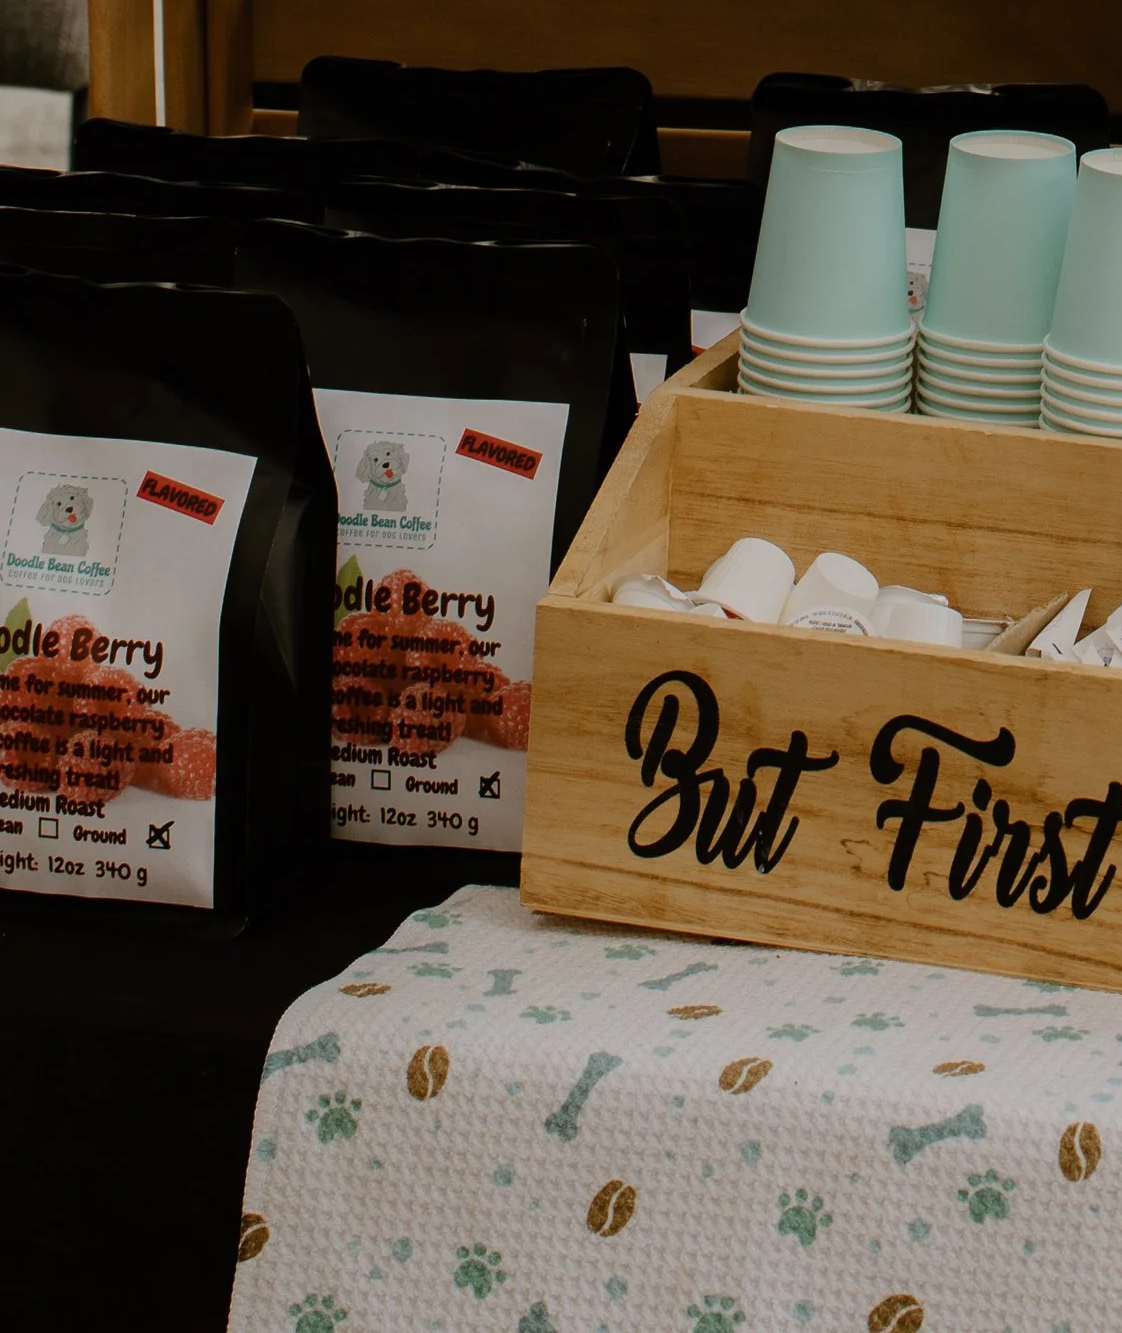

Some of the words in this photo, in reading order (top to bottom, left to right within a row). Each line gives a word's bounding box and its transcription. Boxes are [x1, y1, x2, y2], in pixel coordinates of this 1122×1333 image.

[460, 434, 537, 473] FLAVORED
[141, 477, 217, 519] FLAVORED
[371, 514, 397, 529] Bean
[399, 516, 432, 532] Coffee
[6, 553, 45, 570] Doodle
[47, 558, 74, 573] Bean
[77, 561, 111, 578] Coffee
[402, 582, 494, 632] Berry
[70, 629, 162, 679] Berry
[25, 674, 54, 696] for
[136, 688, 170, 705] our
[66, 711, 164, 741] raspberry
[388, 746, 437, 769] Roast
[624, 670, 840, 874] But
[405, 776, 458, 795] Ground
[0, 789, 50, 813] edium
[55, 795, 105, 819] Roast
[73, 825, 126, 845] Ground
[380, 807, 417, 827] 12oz
[427, 811, 463, 830] 340
[468, 817, 478, 837] g
[48, 856, 85, 875] 12oz
[95, 861, 131, 880] 340
[136, 868, 147, 887] g
